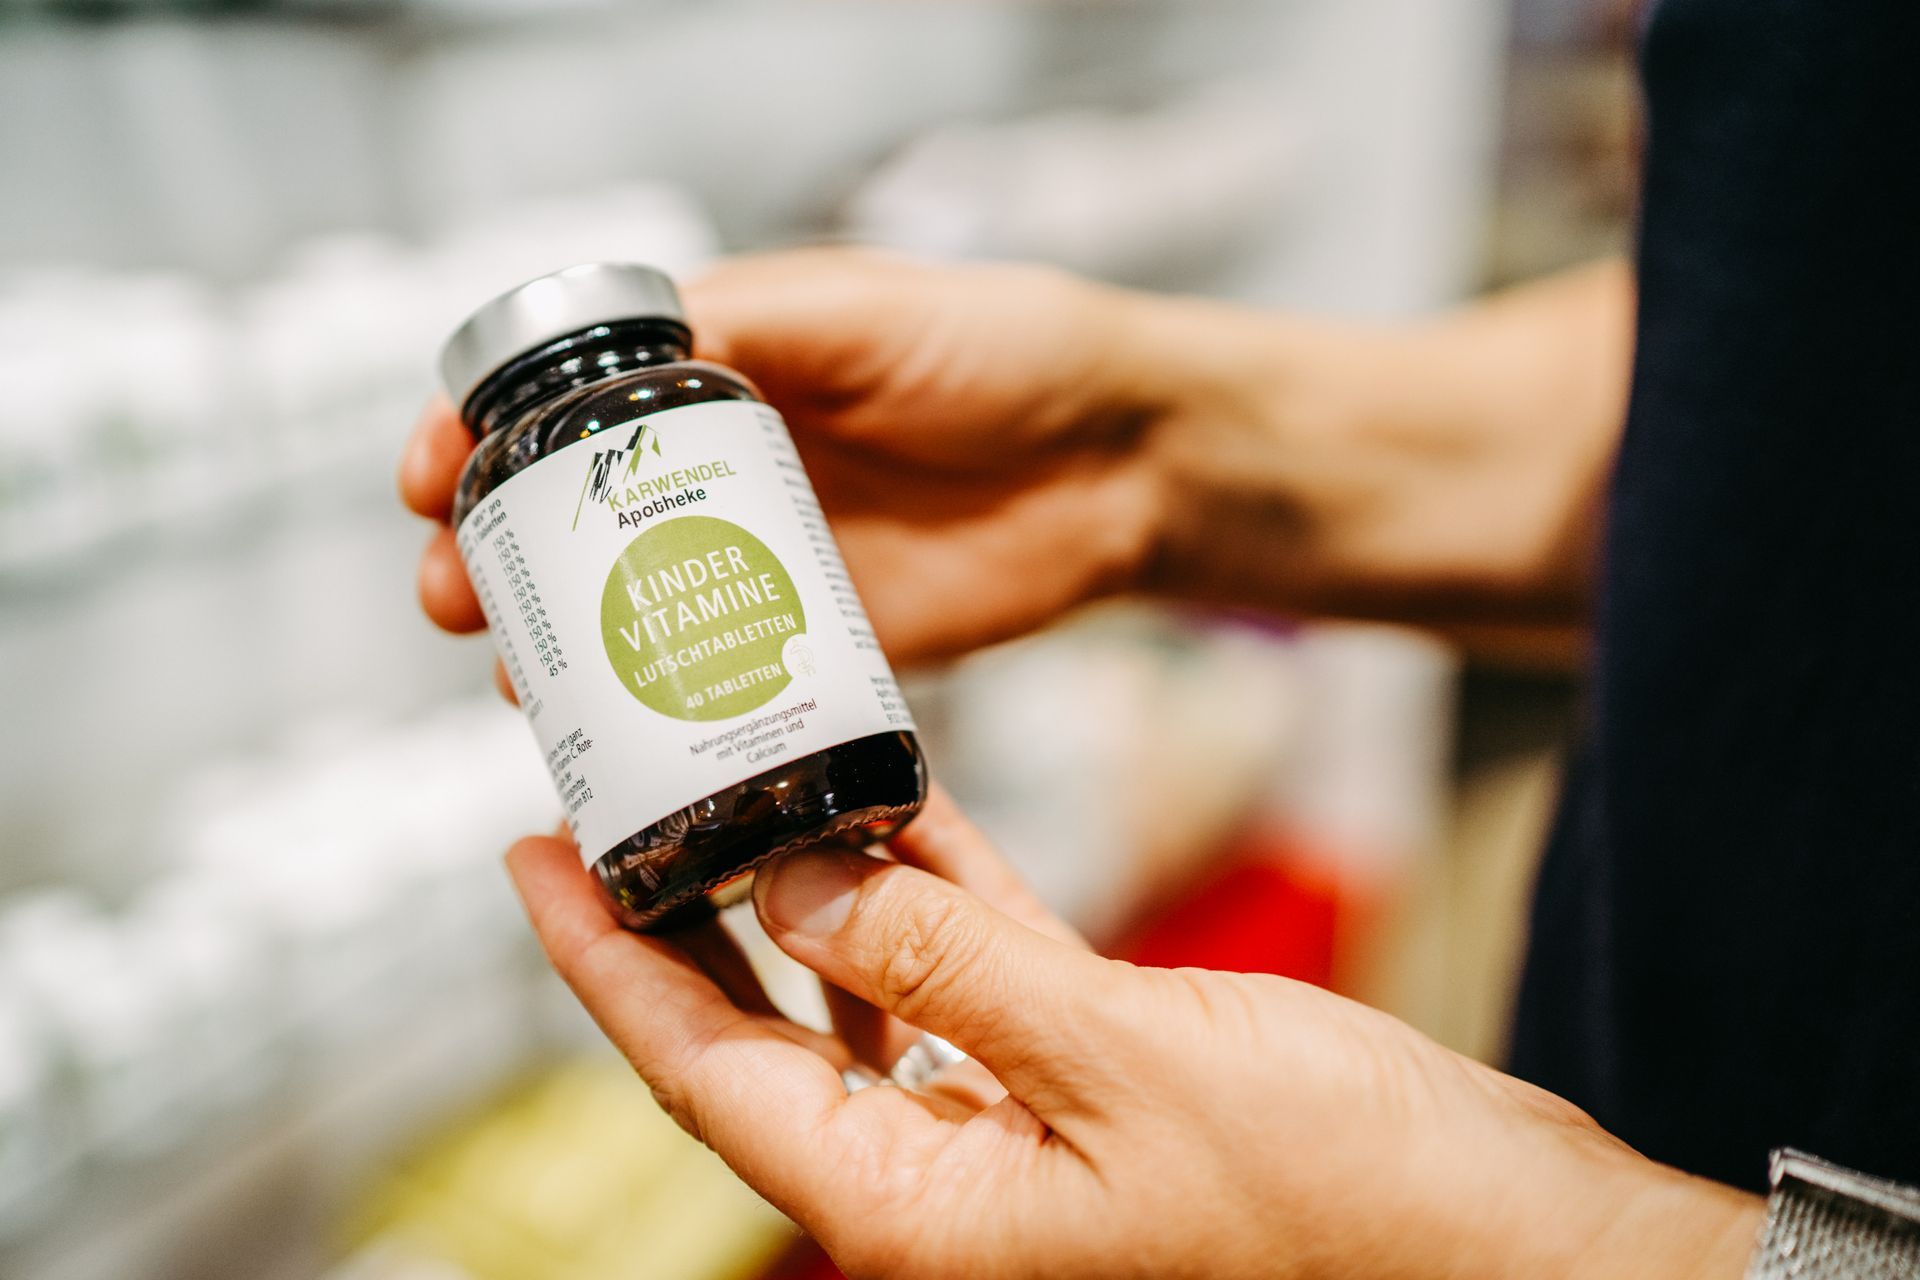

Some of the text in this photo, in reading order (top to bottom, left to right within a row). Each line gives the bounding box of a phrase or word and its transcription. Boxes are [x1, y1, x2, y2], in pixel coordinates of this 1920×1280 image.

[607, 460, 737, 512] KARWENDEL
[488, 499, 502, 514] pro
[617, 488, 707, 529] Apotheke
[505, 528, 514, 540] %
[510, 542, 520, 553] %
[516, 554, 525, 566] %
[508, 568, 530, 589] 150 %
[626, 546, 749, 612] KINDER
[513, 580, 536, 602] 150 %
[519, 594, 541, 615] 150 %
[619, 573, 780, 652] VITAMINE
[524, 606, 546, 628] 150 %
[529, 620, 551, 641] 150 %
[534, 632, 557, 654] 150 %
[633, 613, 797, 688] LUTSCHTABLETTEN
[540, 646, 562, 667] 150 %
[549, 658, 568, 677] 45 %
[686, 662, 782, 709] 40 TABLETTEN
[689, 698, 817, 756] Nahrungsergänzungsmittel
[576, 739, 594, 755] Rote-
[716, 718, 805, 760] mit Vitaminen und
[745, 742, 787, 764] Calcium
[581, 787, 594, 803] B12
